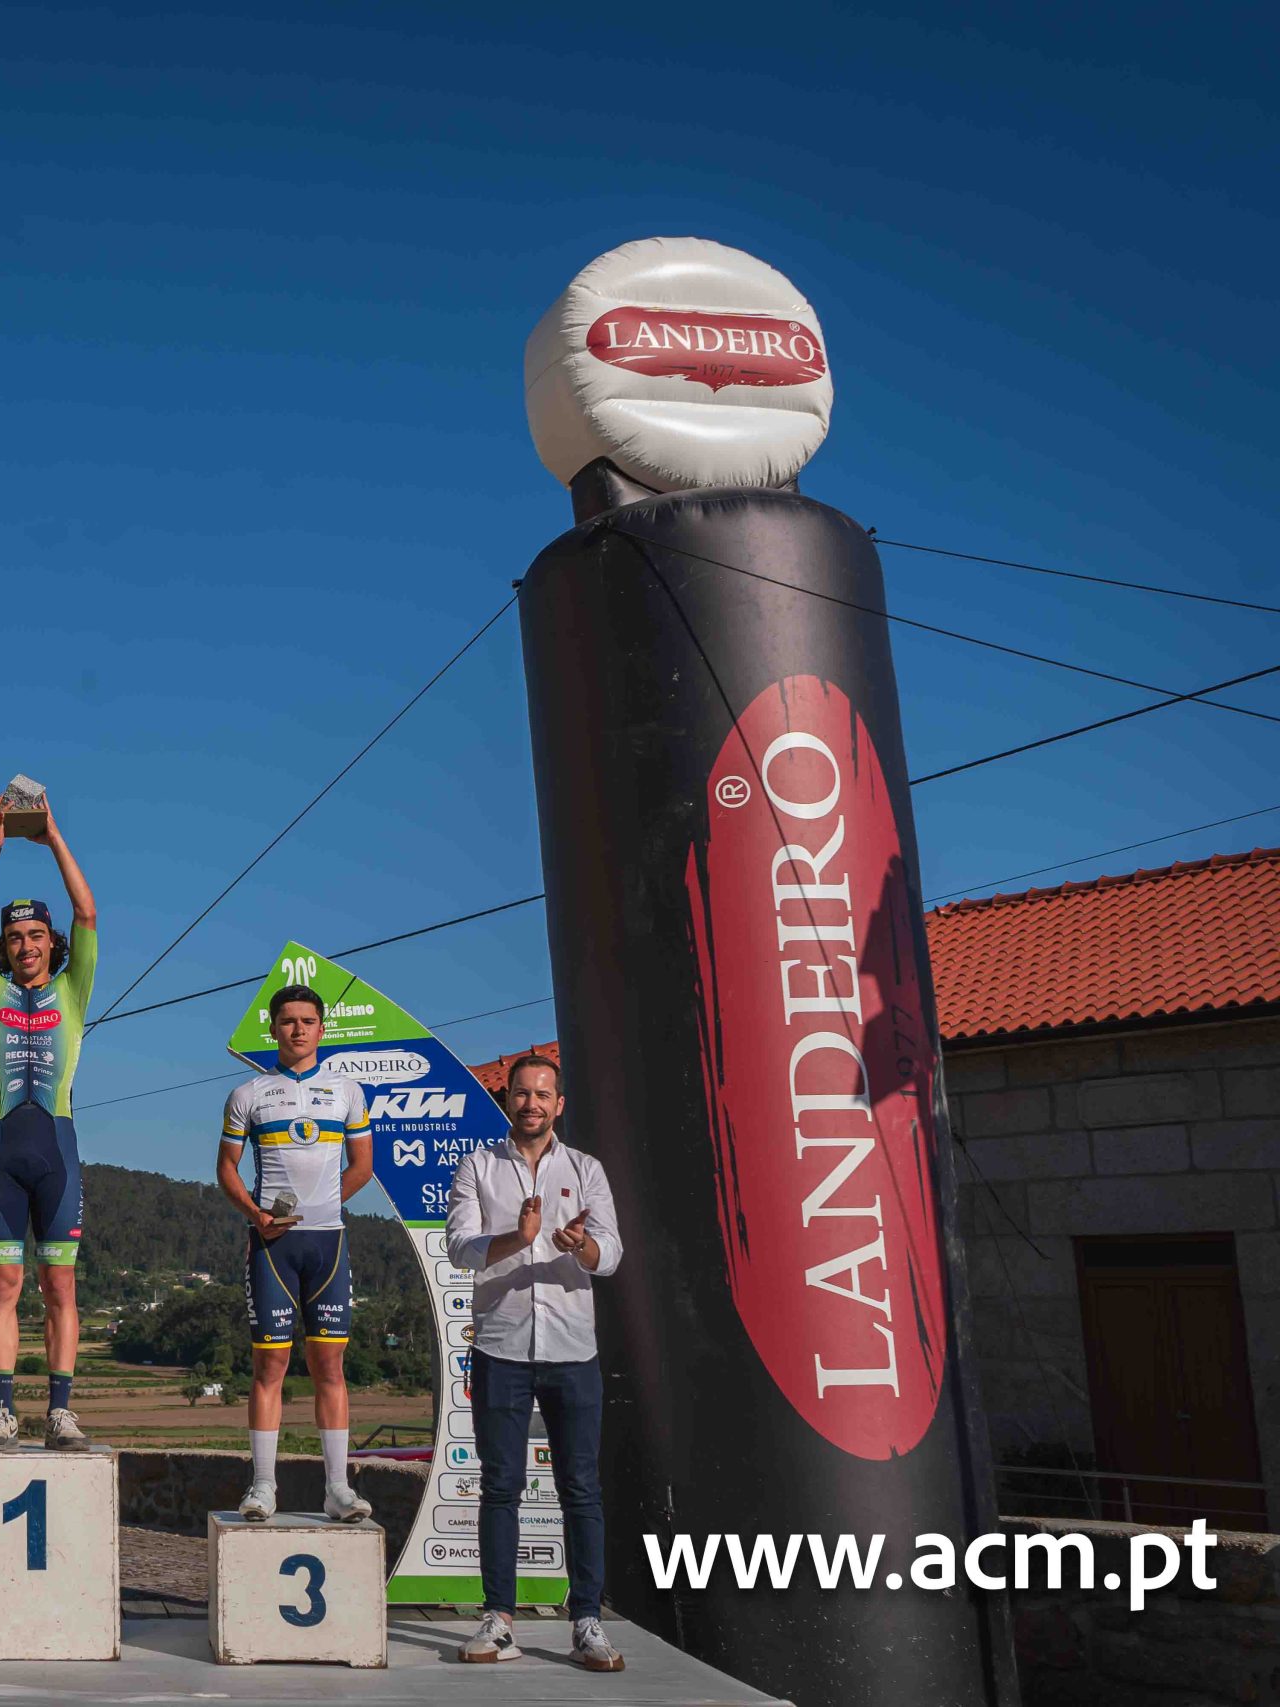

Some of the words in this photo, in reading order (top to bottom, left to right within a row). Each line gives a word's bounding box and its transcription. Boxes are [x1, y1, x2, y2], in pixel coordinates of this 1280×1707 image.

[604, 322, 815, 362] LANDEIRO
[699, 362, 735, 378] 1977
[324, 1001, 375, 1018] iclismo
[1, 1010, 59, 1025] LANDEIRO
[346, 1029, 374, 1038] Matias
[327, 1058, 422, 1073] LANDEIRO
[762, 731, 901, 1399] LANDEIRO
[368, 1087, 467, 1119] KTM
[375, 1123, 397, 1132] BIKE
[401, 1122, 457, 1132] INDUSTRIES
[272, 1307, 293, 1317] MAAS
[317, 1304, 344, 1312] MAAS
[2, 1479, 47, 1571] 1
[520, 1517, 564, 1525] EGURAMOS
[278, 1553, 327, 1628] 3
